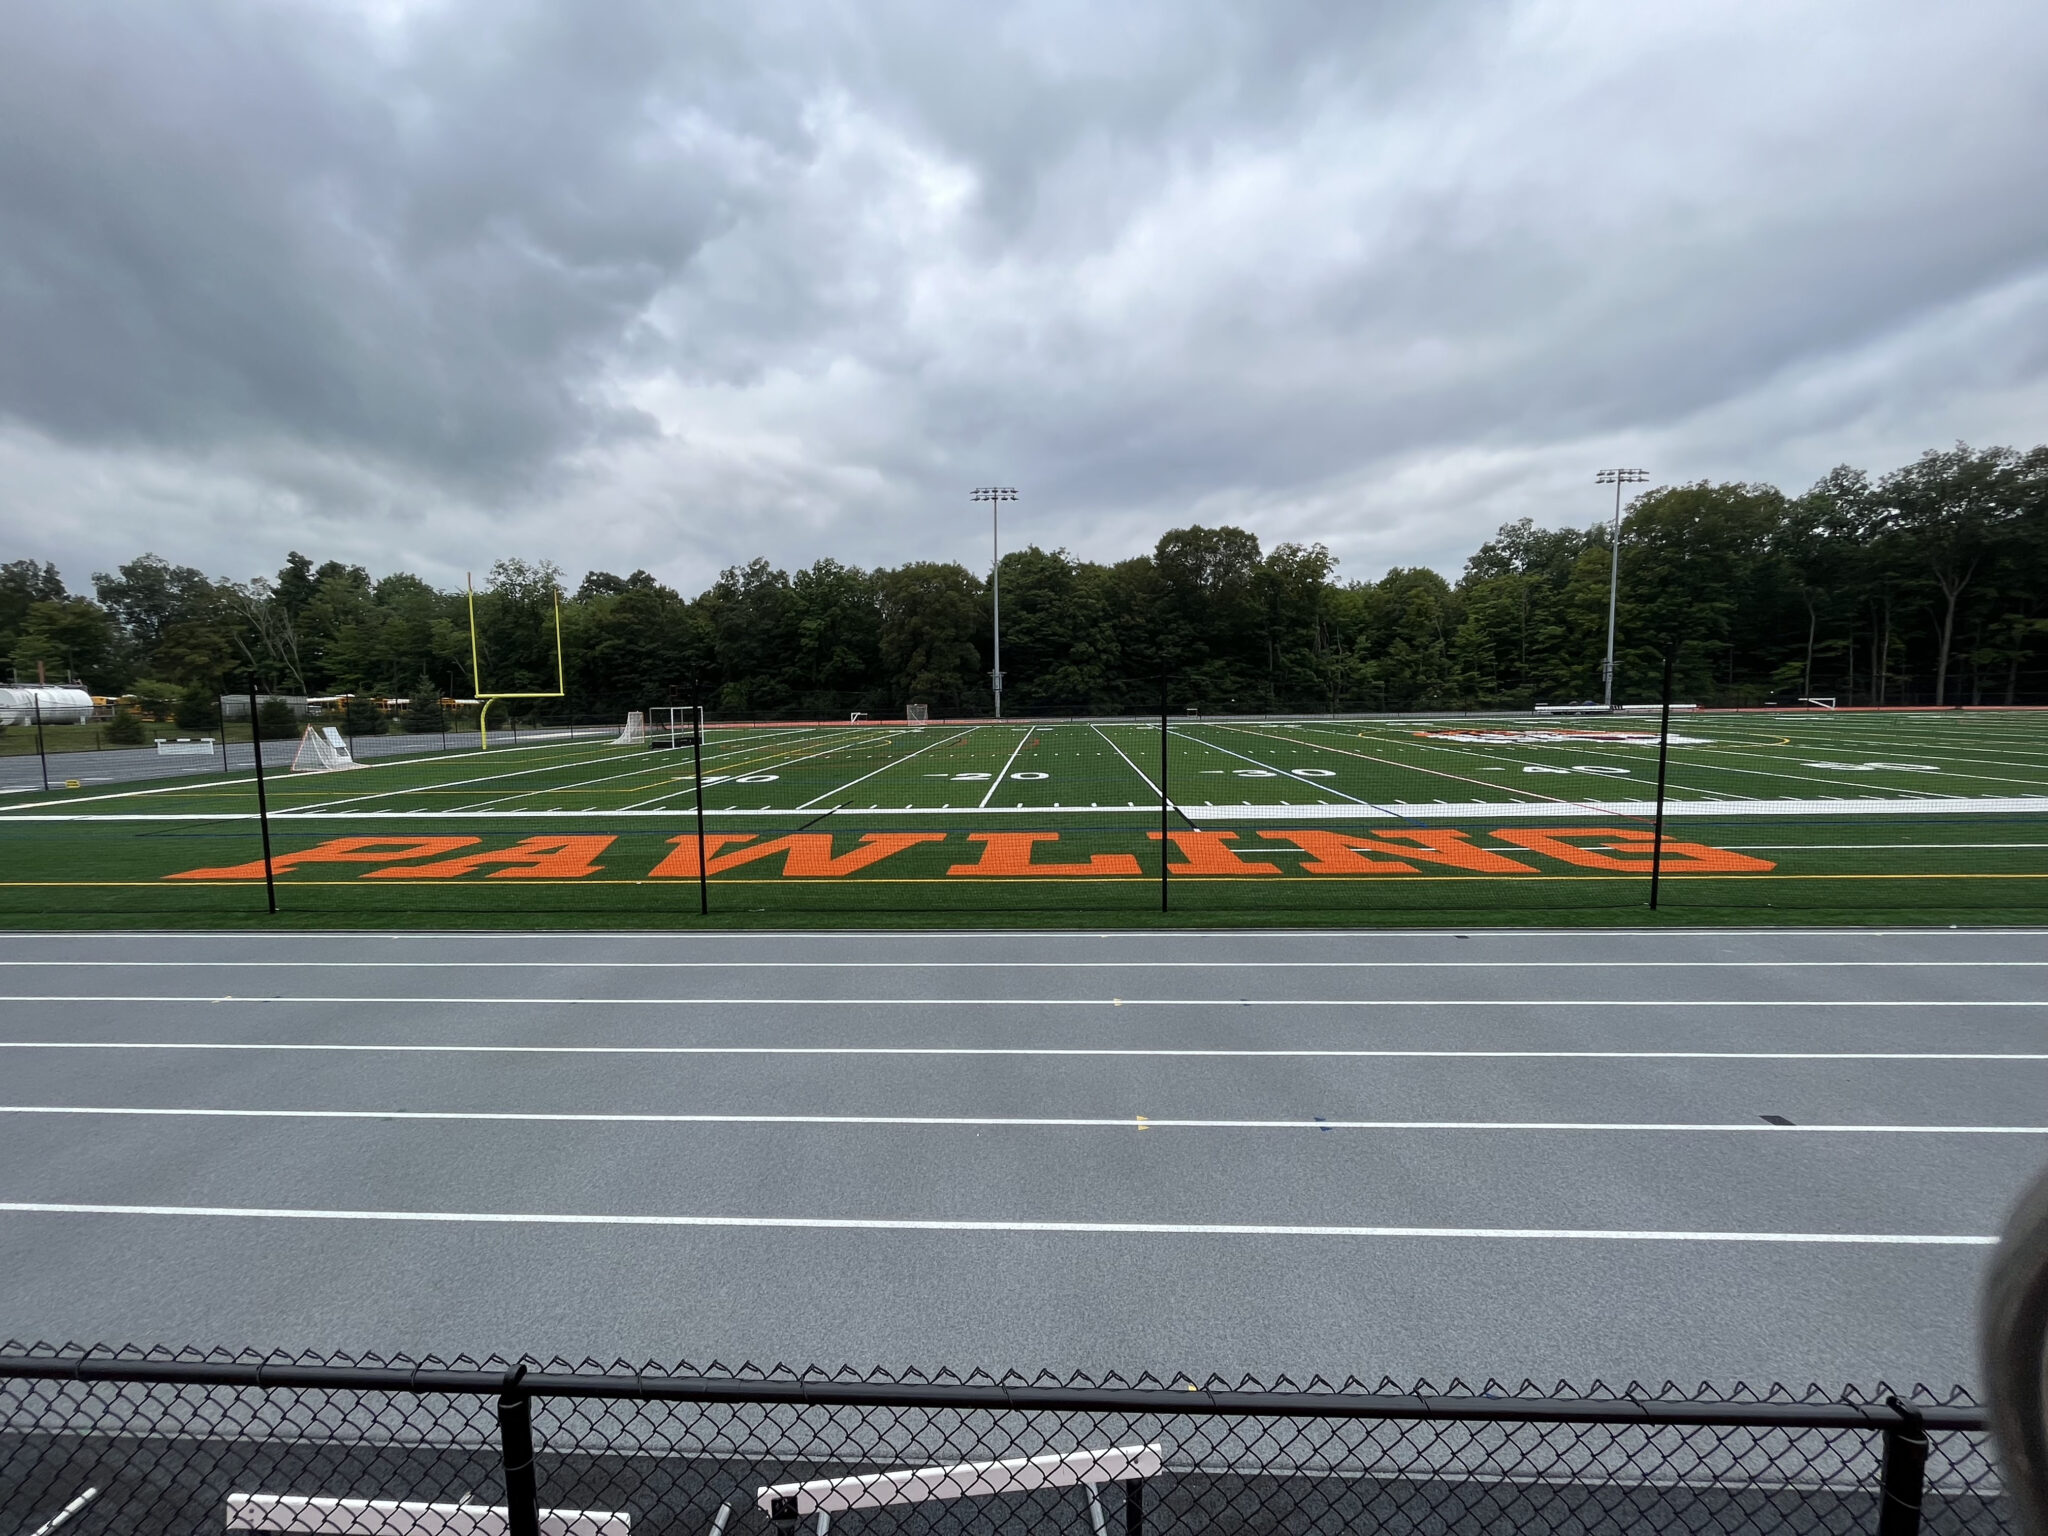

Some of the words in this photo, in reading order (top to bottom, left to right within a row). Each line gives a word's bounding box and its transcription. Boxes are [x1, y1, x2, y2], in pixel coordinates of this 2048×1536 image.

[1231, 768, 1337, 777] 30
[1522, 765, 1632, 774] 40
[950, 772, 1050, 781] 20
[160, 827, 1778, 879] PAWLING
